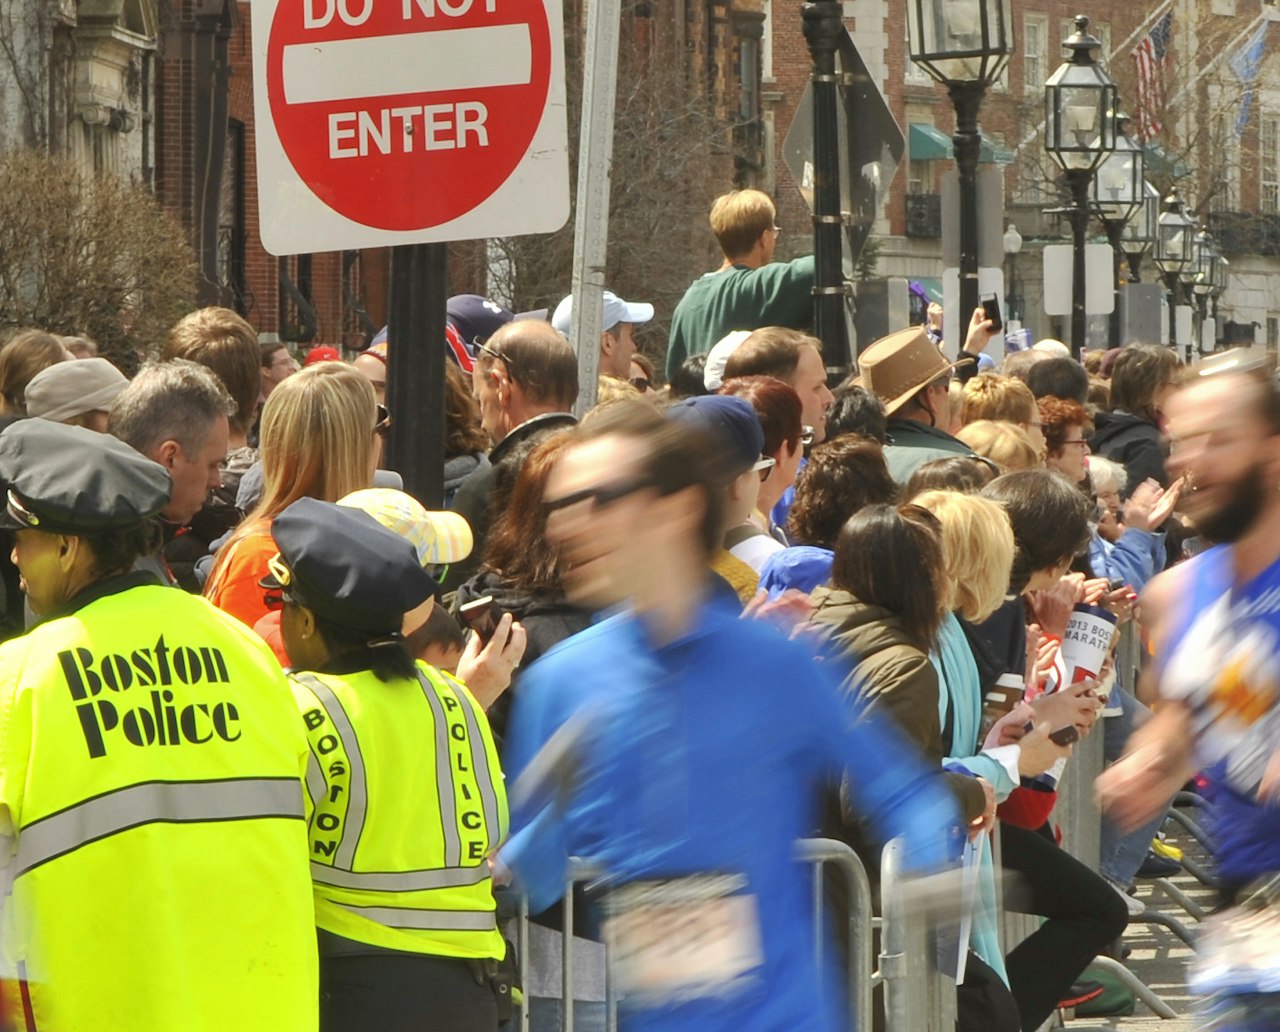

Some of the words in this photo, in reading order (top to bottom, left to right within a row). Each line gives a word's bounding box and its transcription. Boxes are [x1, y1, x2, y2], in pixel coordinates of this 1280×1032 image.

[328, 101, 489, 159] ENTER
[58, 634, 231, 701] Boston
[75, 690, 242, 759] Police
[303, 707, 346, 857] BOSTON
[444, 696, 485, 860] POLICE
